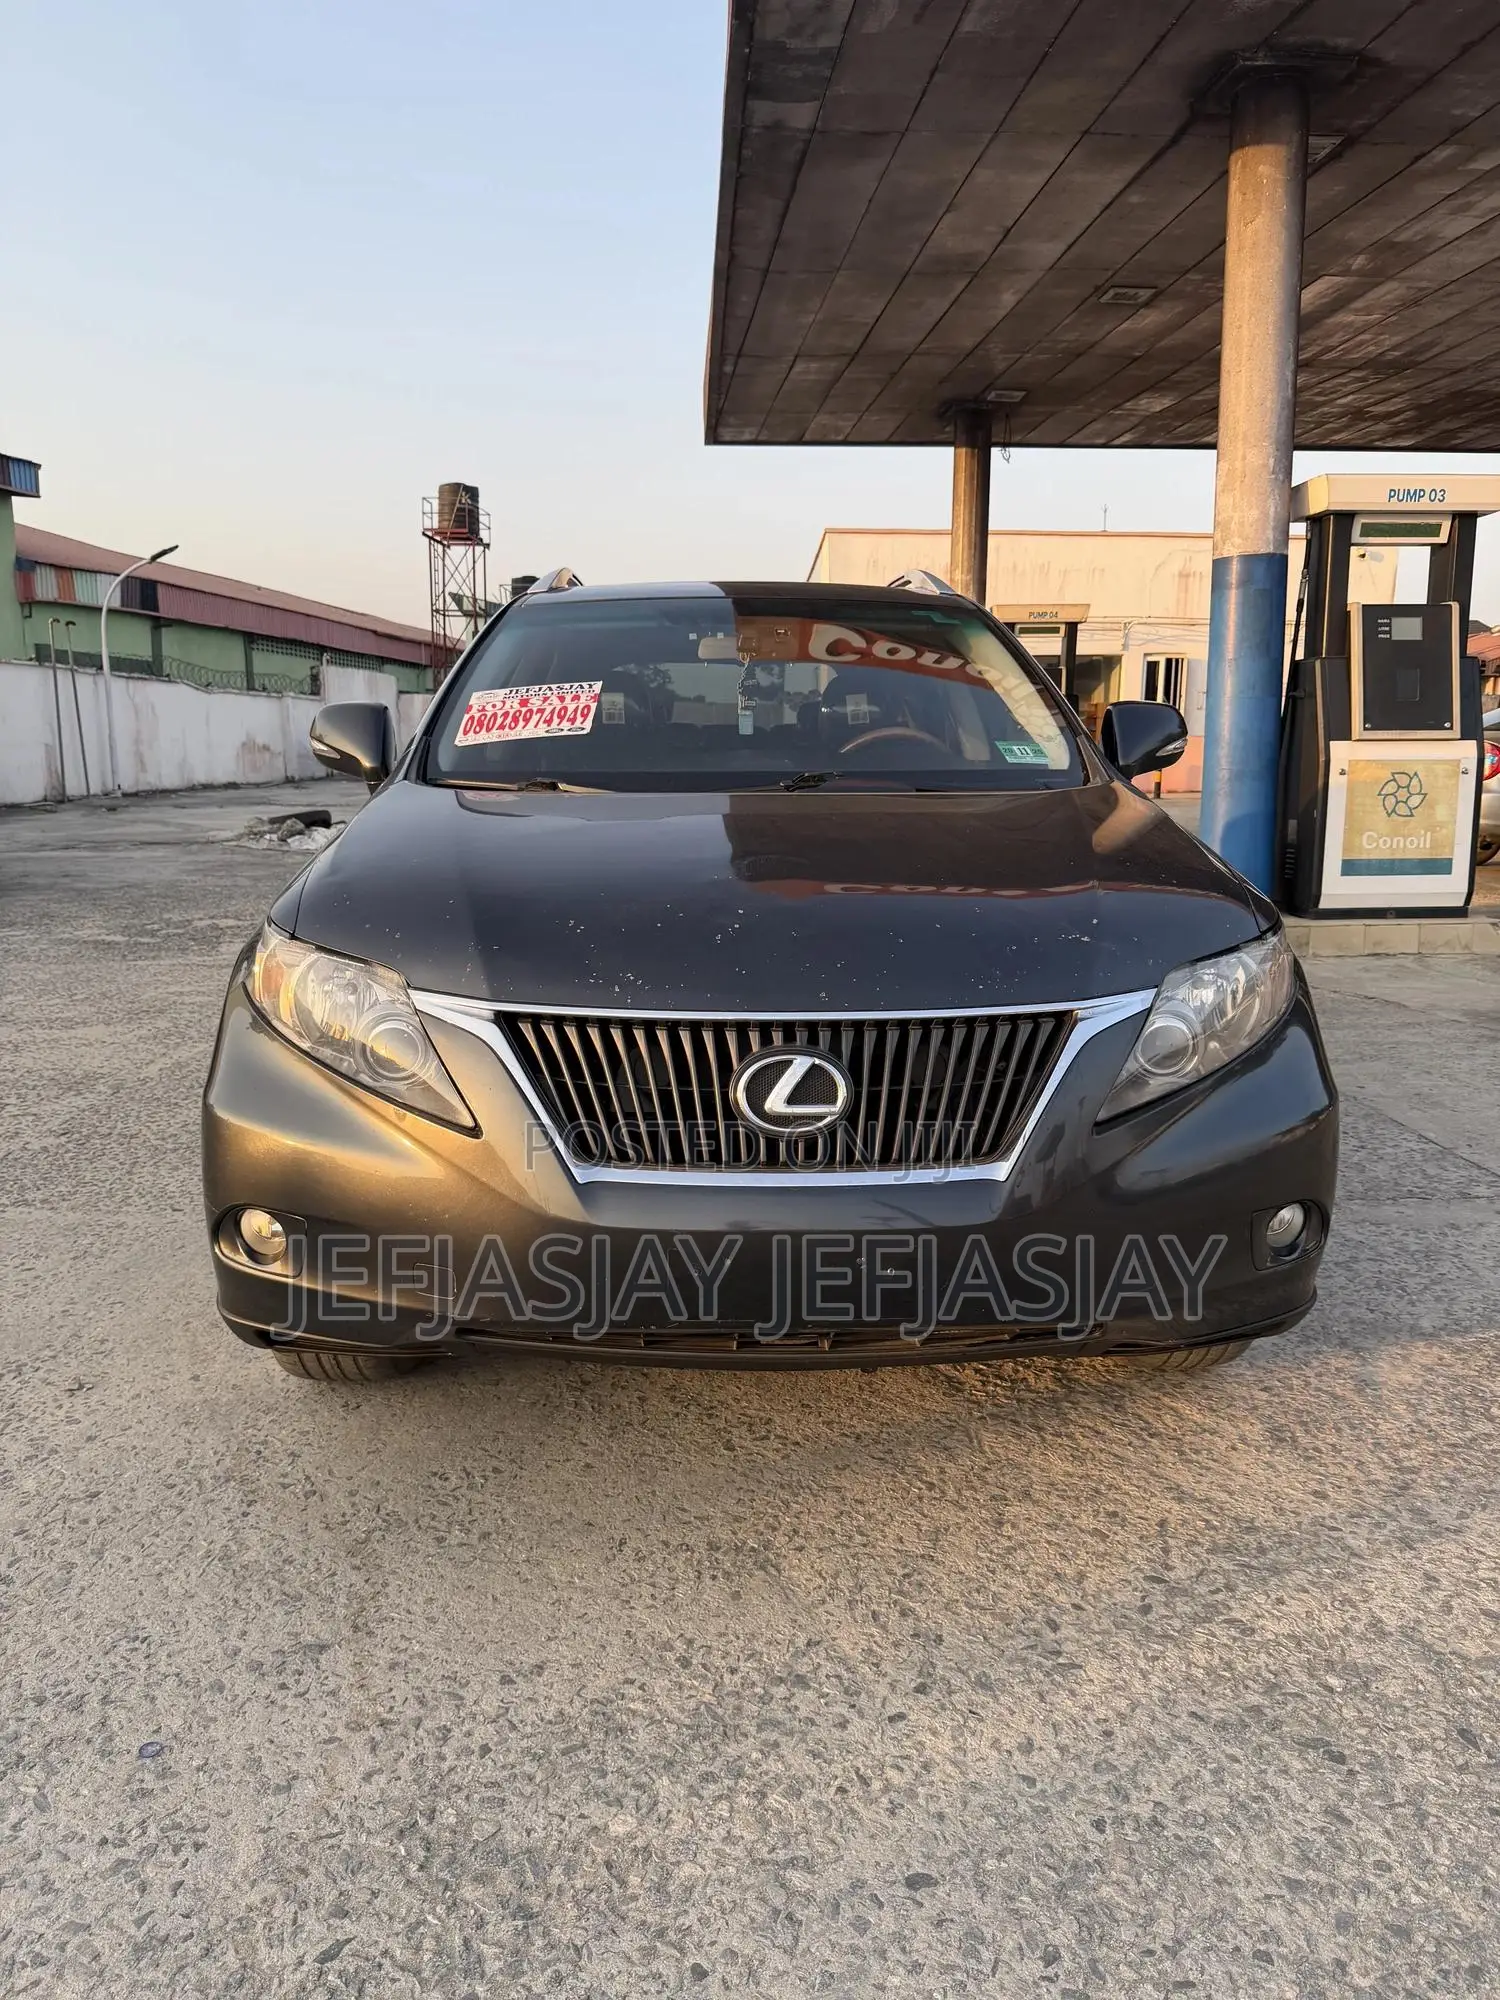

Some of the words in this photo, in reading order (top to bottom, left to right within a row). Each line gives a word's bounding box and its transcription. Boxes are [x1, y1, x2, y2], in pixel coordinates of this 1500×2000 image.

[1388, 488, 1426, 503] PUMP
[1428, 488, 1446, 503] 03
[1028, 611, 1048, 620] PUMP
[1049, 611, 1059, 619] 04
[502, 692, 548, 700] MOTORS
[550, 688, 596, 696] LIMITED
[503, 682, 598, 696] JEFJASJAY
[471, 700, 520, 713] FOR
[526, 693, 597, 708] SALE
[462, 704, 592, 736] 08028974949
[1016, 746, 1031, 756] 11
[1361, 830, 1432, 849] Conoil
